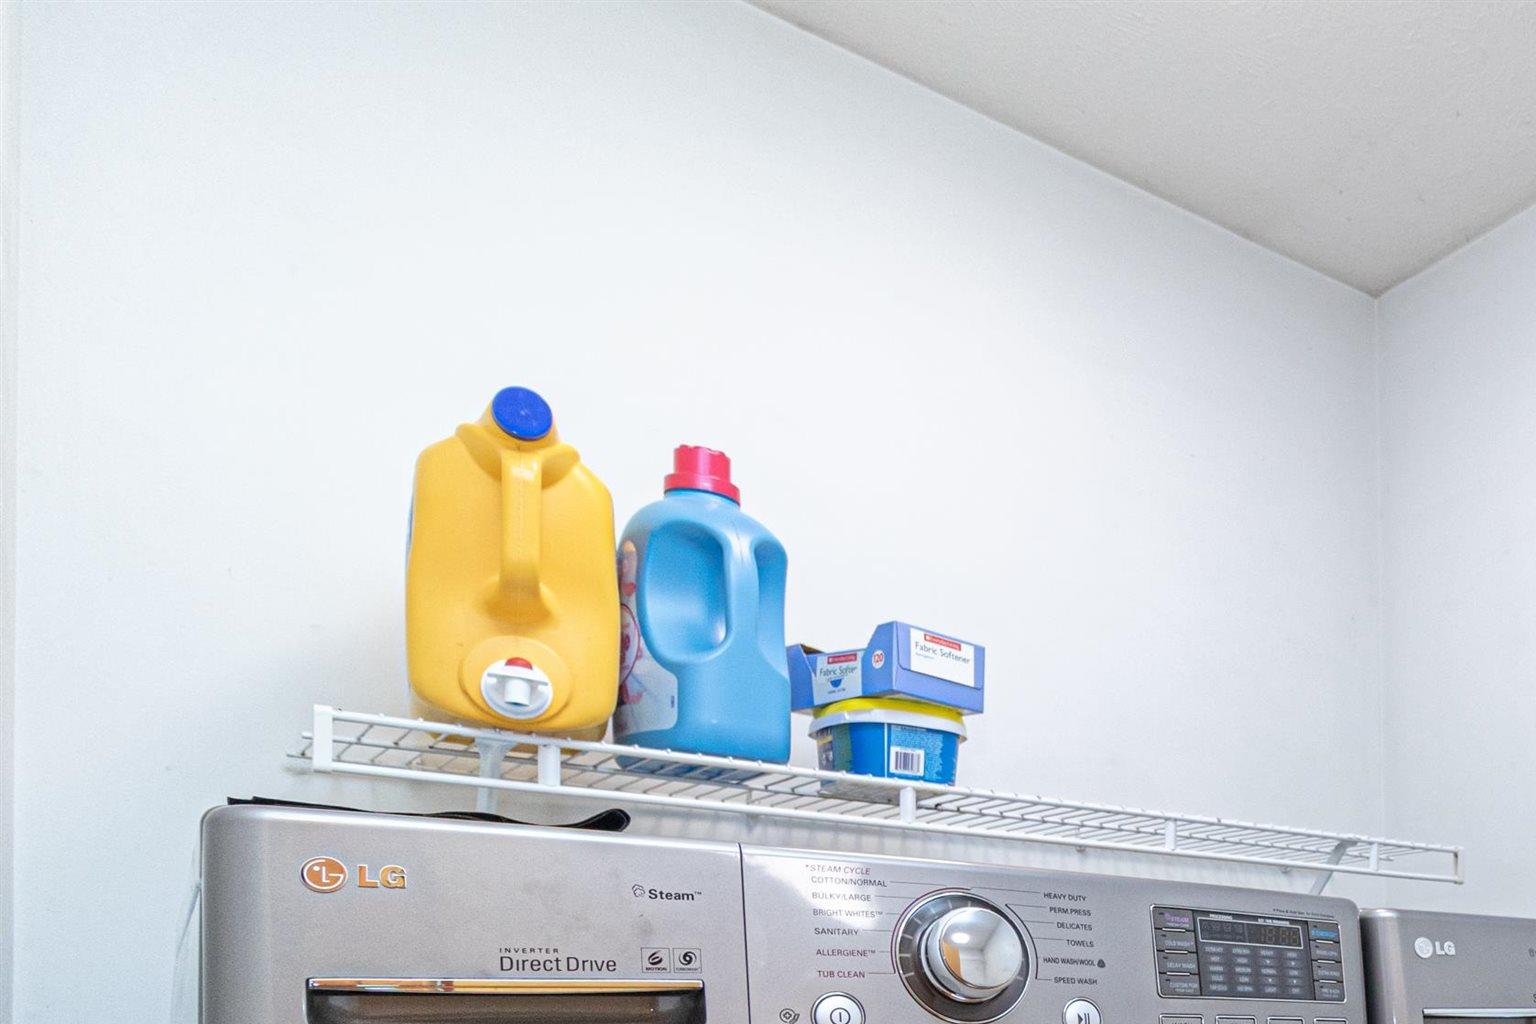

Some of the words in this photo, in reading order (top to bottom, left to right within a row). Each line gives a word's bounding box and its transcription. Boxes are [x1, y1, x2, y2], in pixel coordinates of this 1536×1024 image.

[915, 641, 937, 656] Fabric
[940, 648, 970, 664] Softener
[843, 866, 872, 876] CYCLE
[357, 864, 408, 889] LG
[811, 876, 888, 888] COTTON/NORMAL
[1043, 891, 1066, 900] HEAVY
[1068, 893, 1087, 902] DUTY
[812, 908, 843, 918] BRIGHT
[1056, 921, 1093, 931] DELICATES
[814, 927, 859, 936] SANITARY
[1066, 939, 1095, 948] TOWELS
[1435, 941, 1456, 955] LG
[500, 956, 562, 972] Direct
[566, 957, 617, 972] Drive
[817, 970, 835, 978] TUB
[837, 971, 866, 979] CLEAN
[1053, 976, 1076, 985] SPEED
[1077, 978, 1098, 986] WASH
